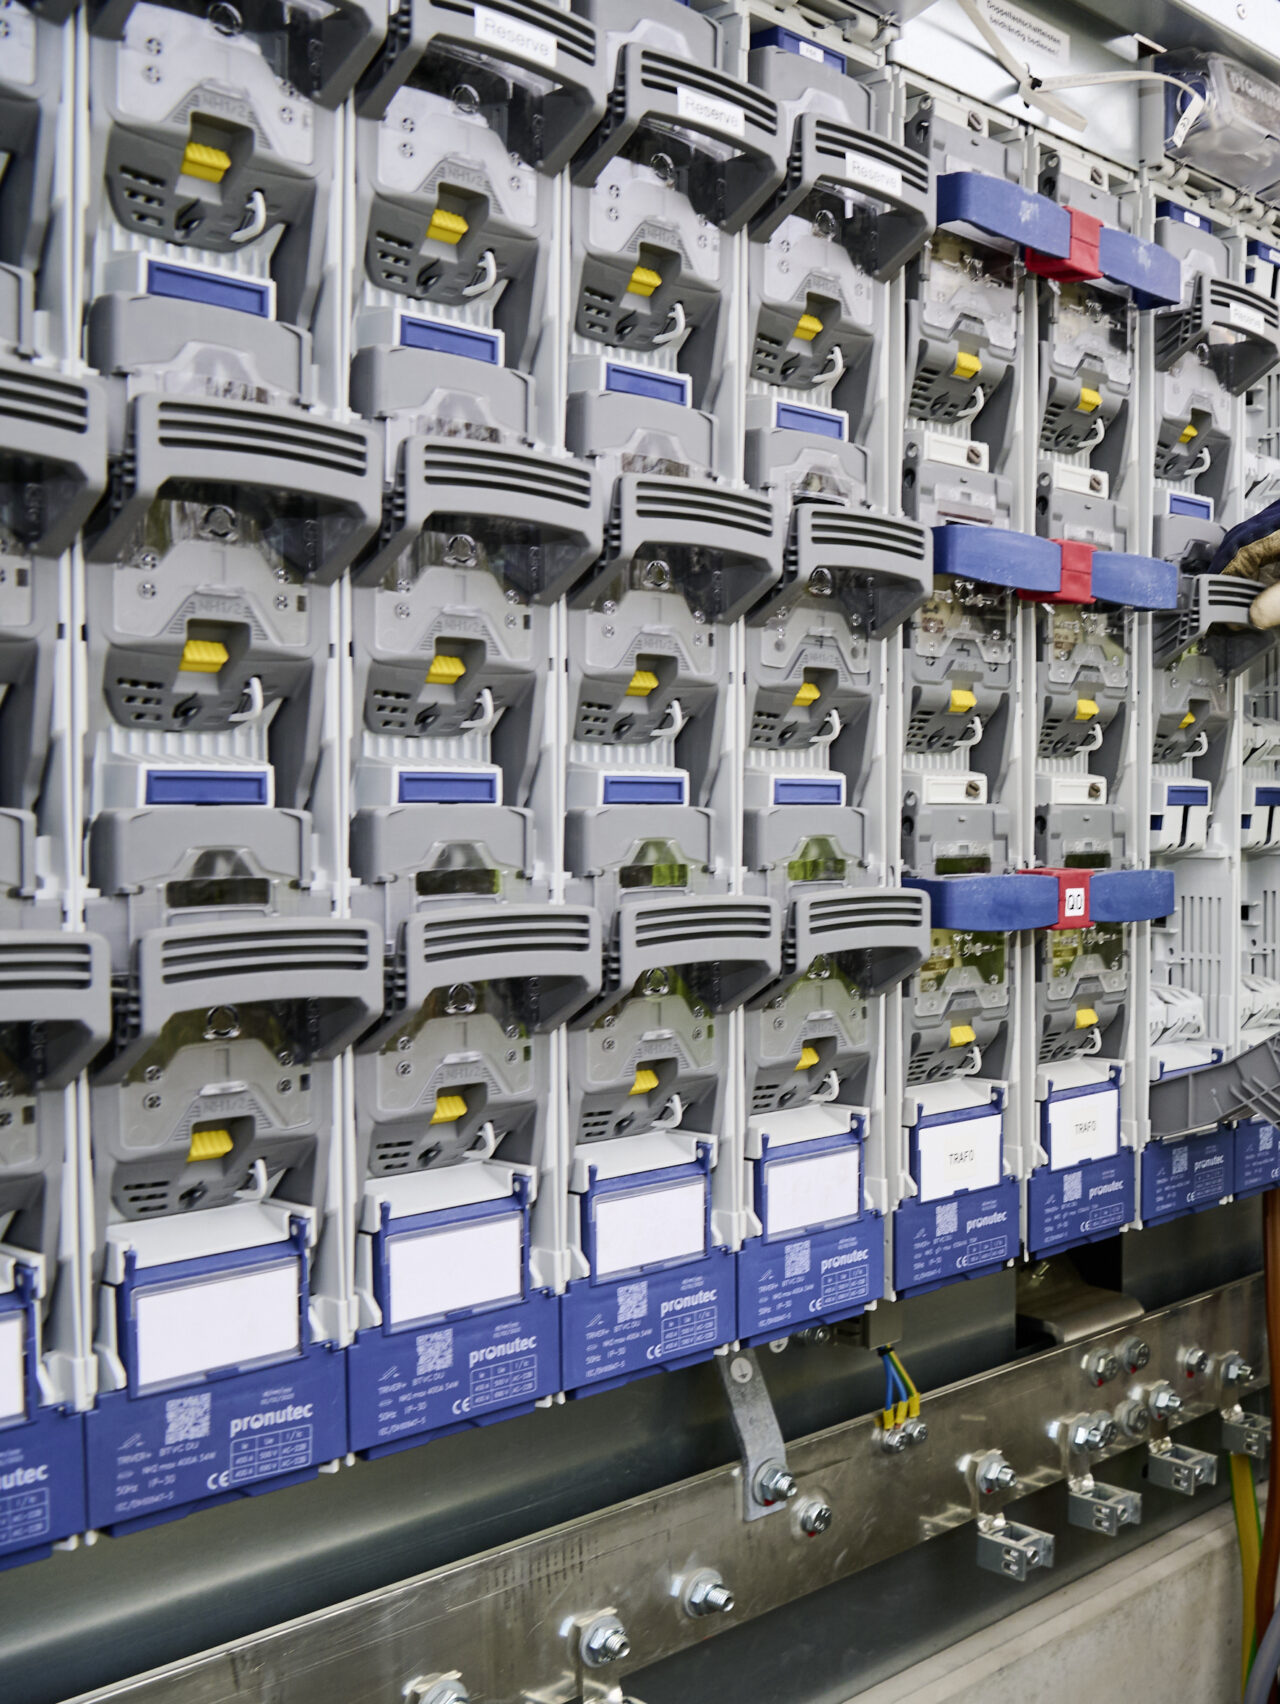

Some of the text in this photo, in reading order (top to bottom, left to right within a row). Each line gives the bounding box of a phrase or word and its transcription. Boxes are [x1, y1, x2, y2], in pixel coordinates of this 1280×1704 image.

[484, 17, 549, 56] Reserve
[685, 95, 739, 127] Reserve
[851, 160, 897, 188] Reserve
[948, 1149, 974, 1165] TRAFO
[966, 1210, 1007, 1234] pronutec
[820, 1248, 869, 1275] pronutec
[660, 1288, 718, 1318] pronutec
[468, 1335, 538, 1369] pronutec
[230, 1403, 314, 1438] pronutec
